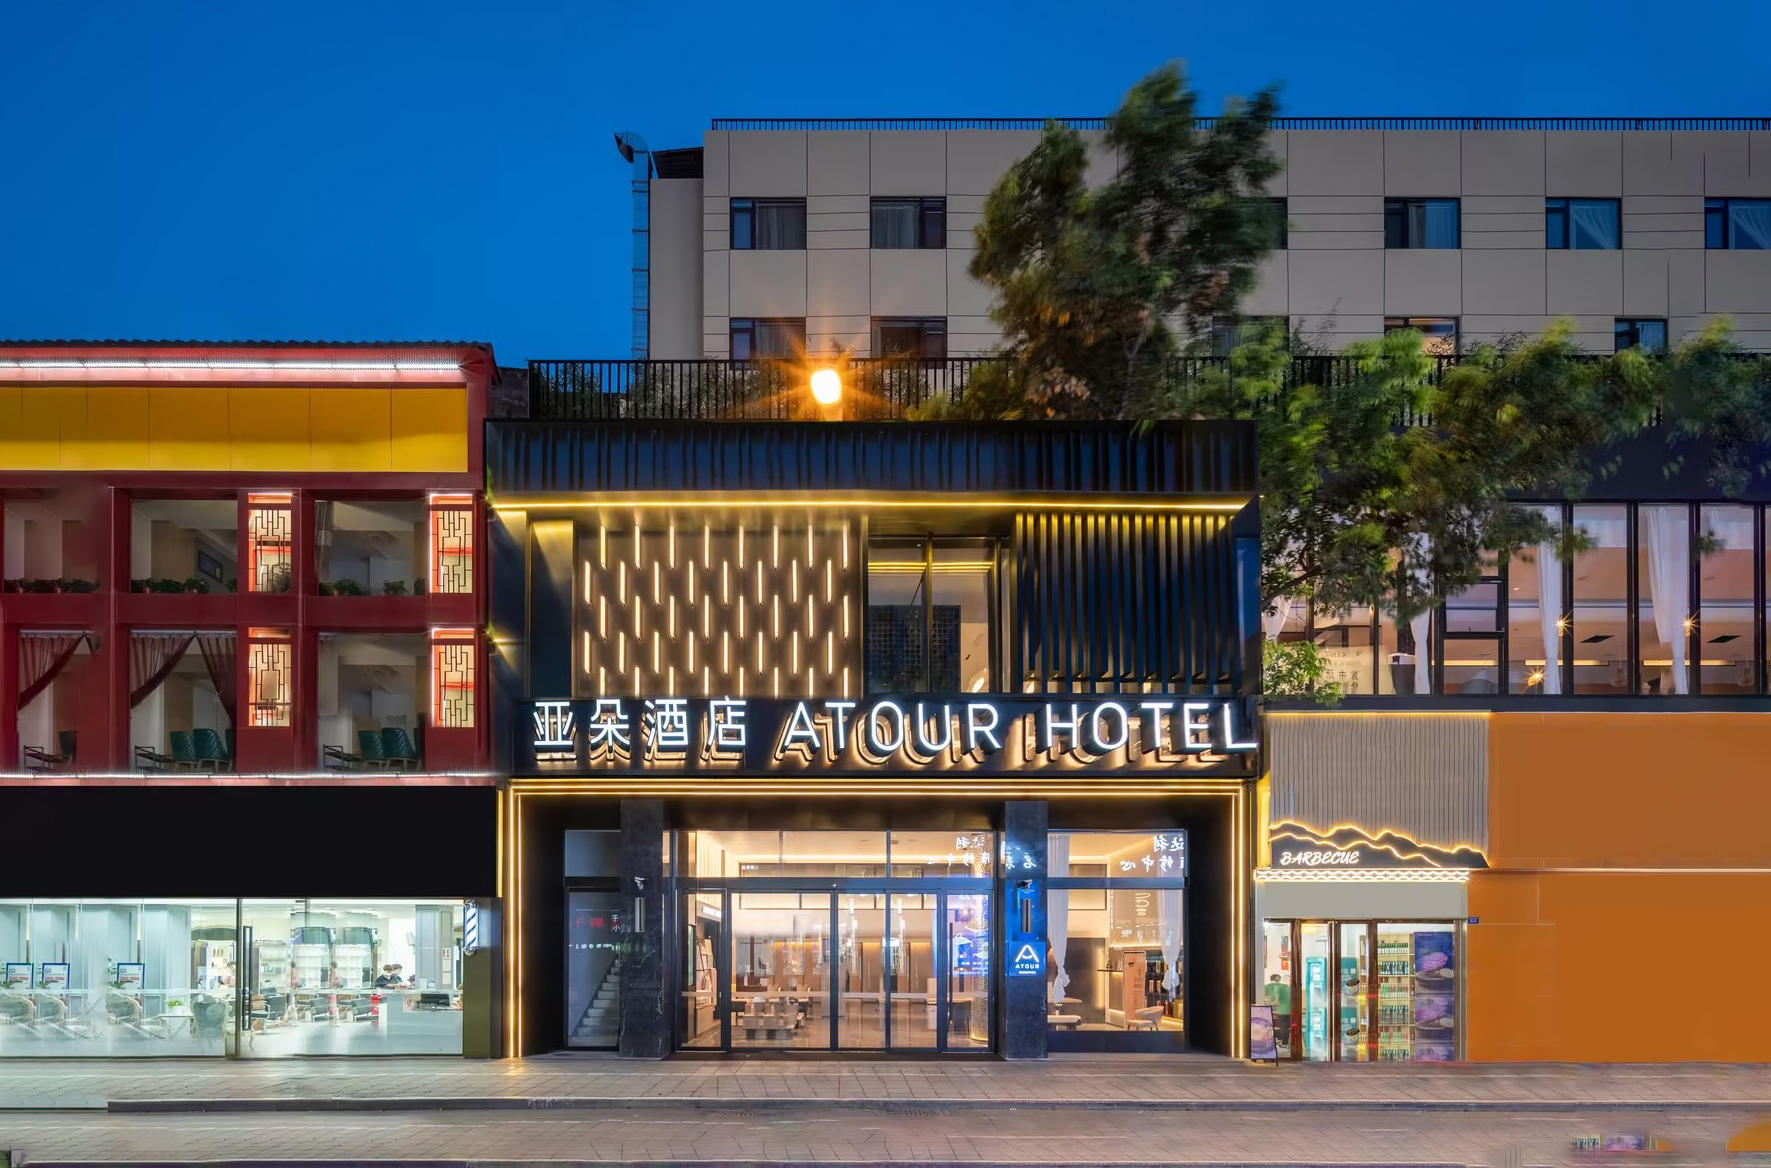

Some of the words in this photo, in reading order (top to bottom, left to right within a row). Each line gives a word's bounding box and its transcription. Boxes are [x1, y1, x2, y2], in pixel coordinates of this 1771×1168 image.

[533, 696, 747, 746] 亚朵酒店
[784, 701, 1002, 750] ATOUR
[1045, 701, 1258, 750] HOTEL
[1279, 851, 1360, 866] BARBECUE
